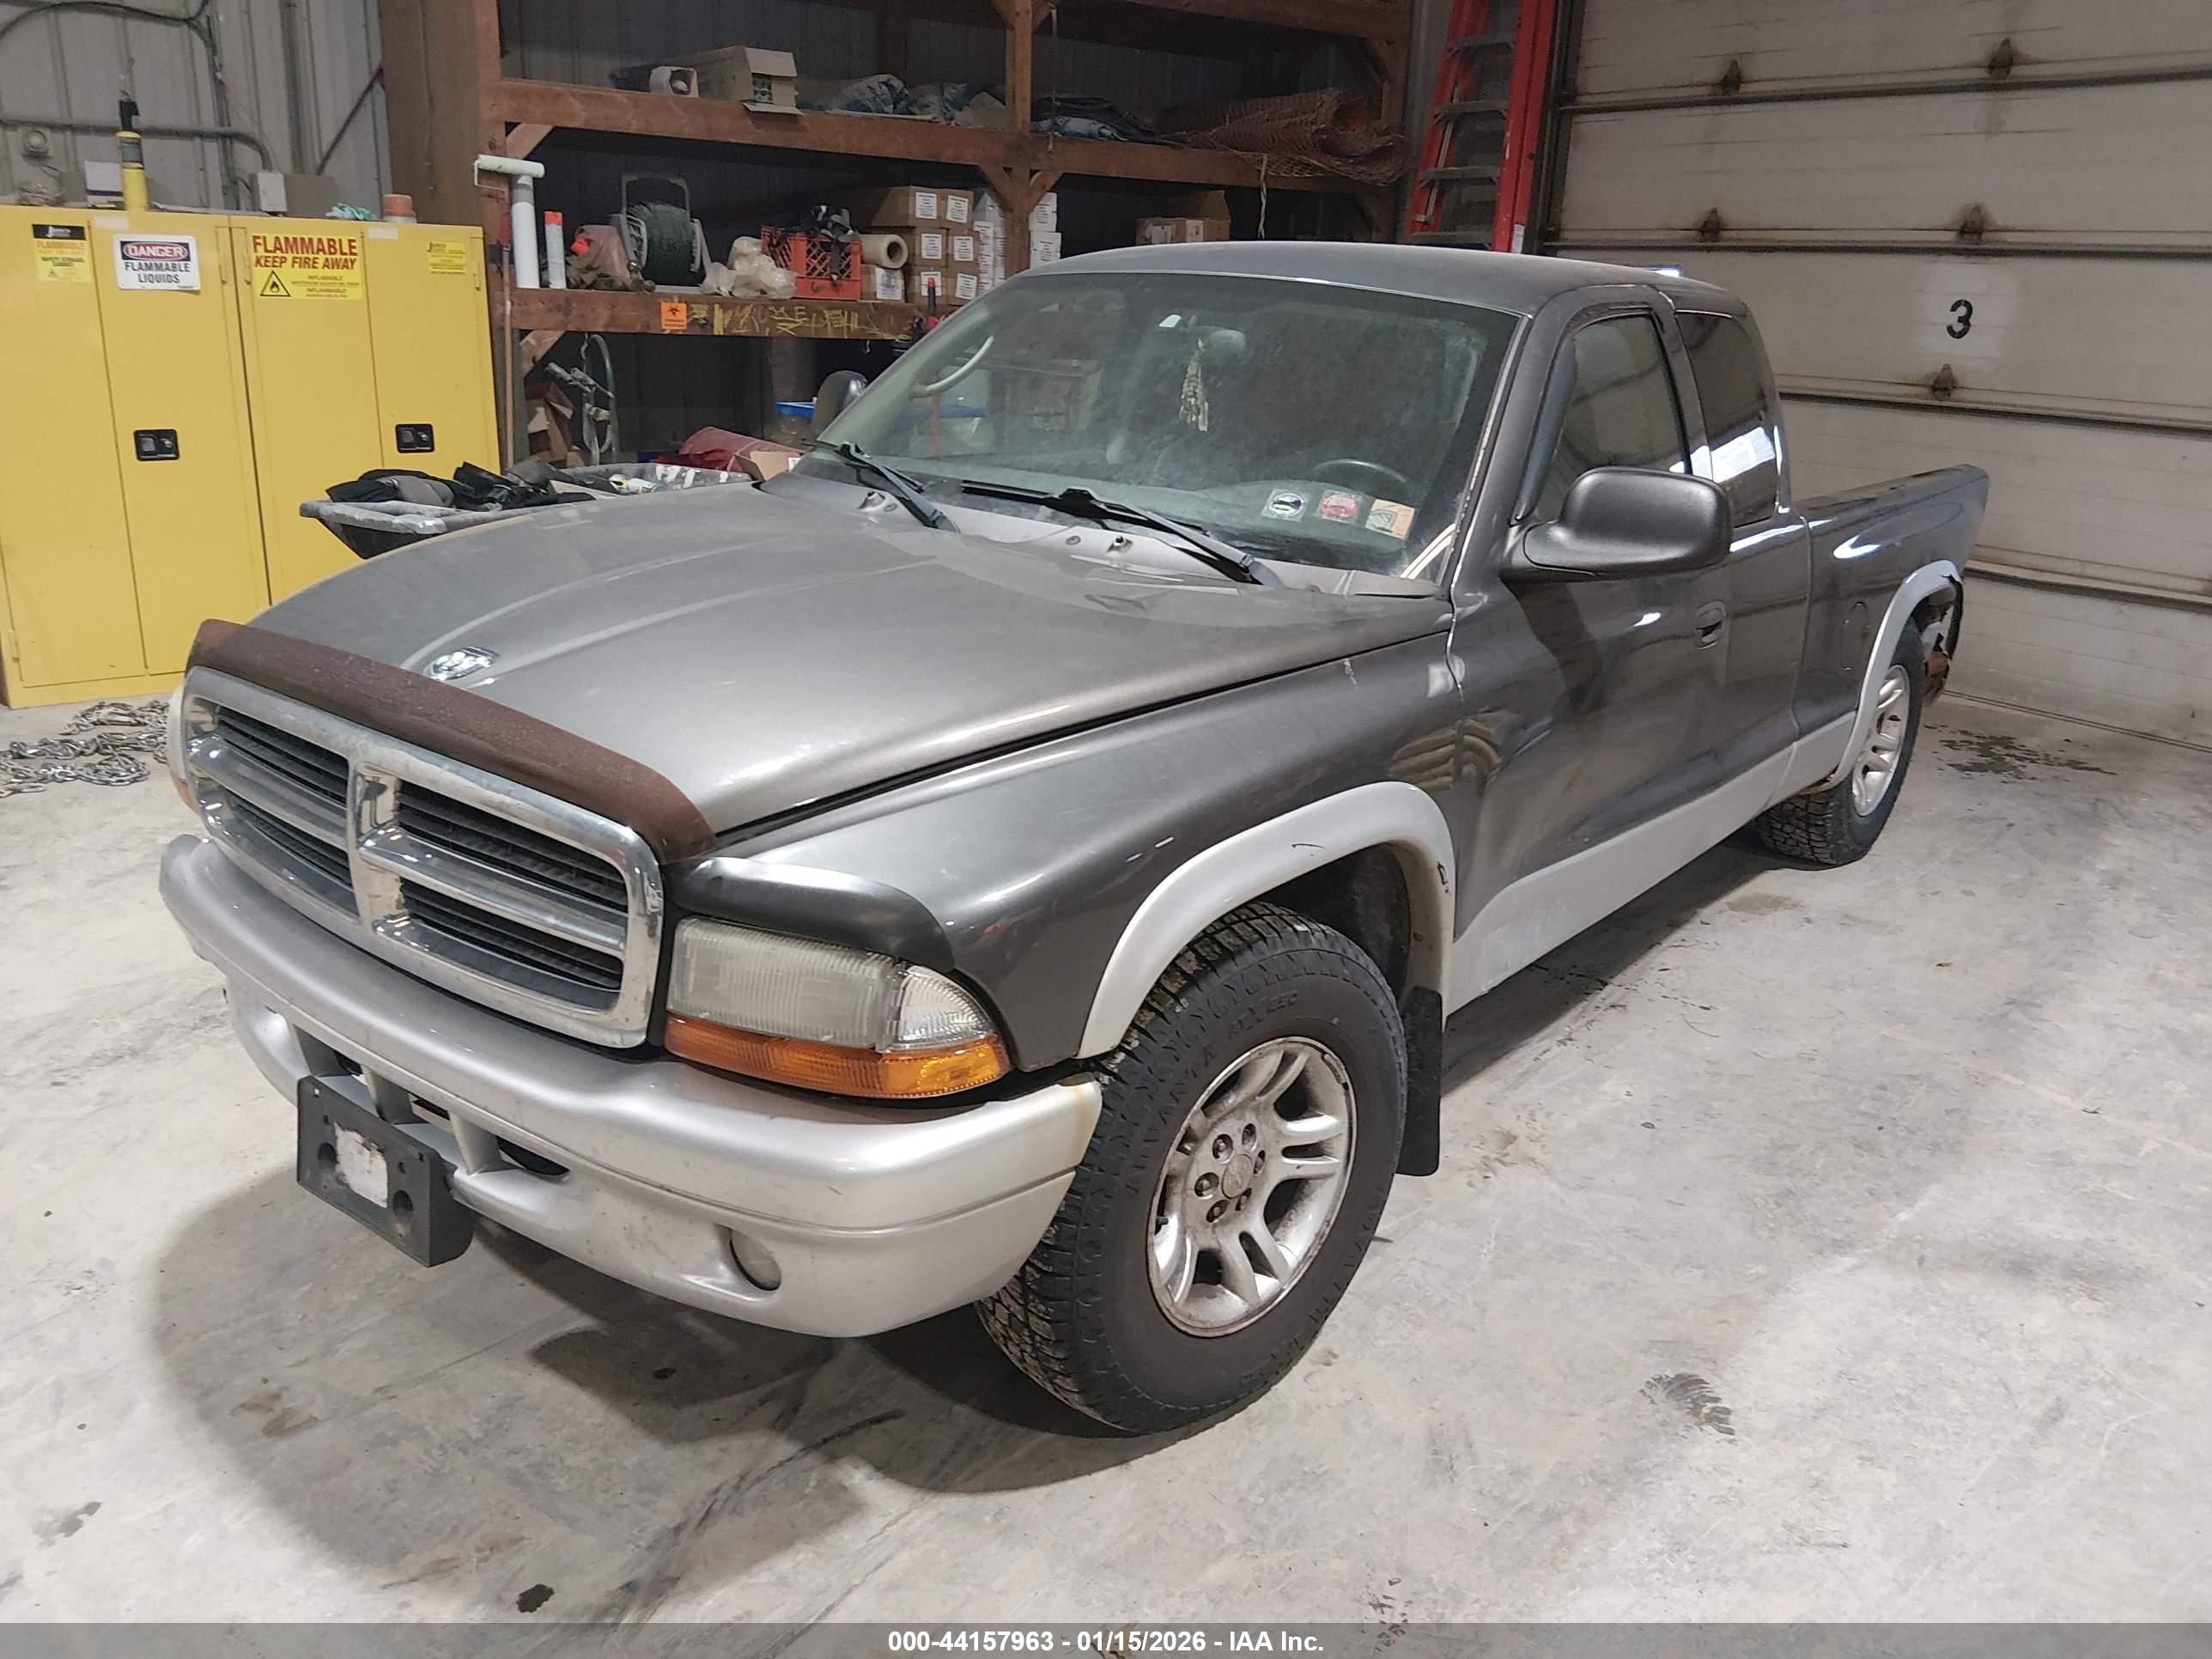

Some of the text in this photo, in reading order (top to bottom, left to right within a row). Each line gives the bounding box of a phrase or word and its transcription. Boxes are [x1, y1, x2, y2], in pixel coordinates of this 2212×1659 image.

[126, 245, 184, 258] DANGER
[252, 235, 358, 256] FLAMMABLE
[124, 261, 191, 273] FLAMMABLE
[254, 255, 357, 270] KEEP FIRE AWAY
[137, 273, 180, 284] LIQUIDS
[1947, 300, 1973, 339] 3
